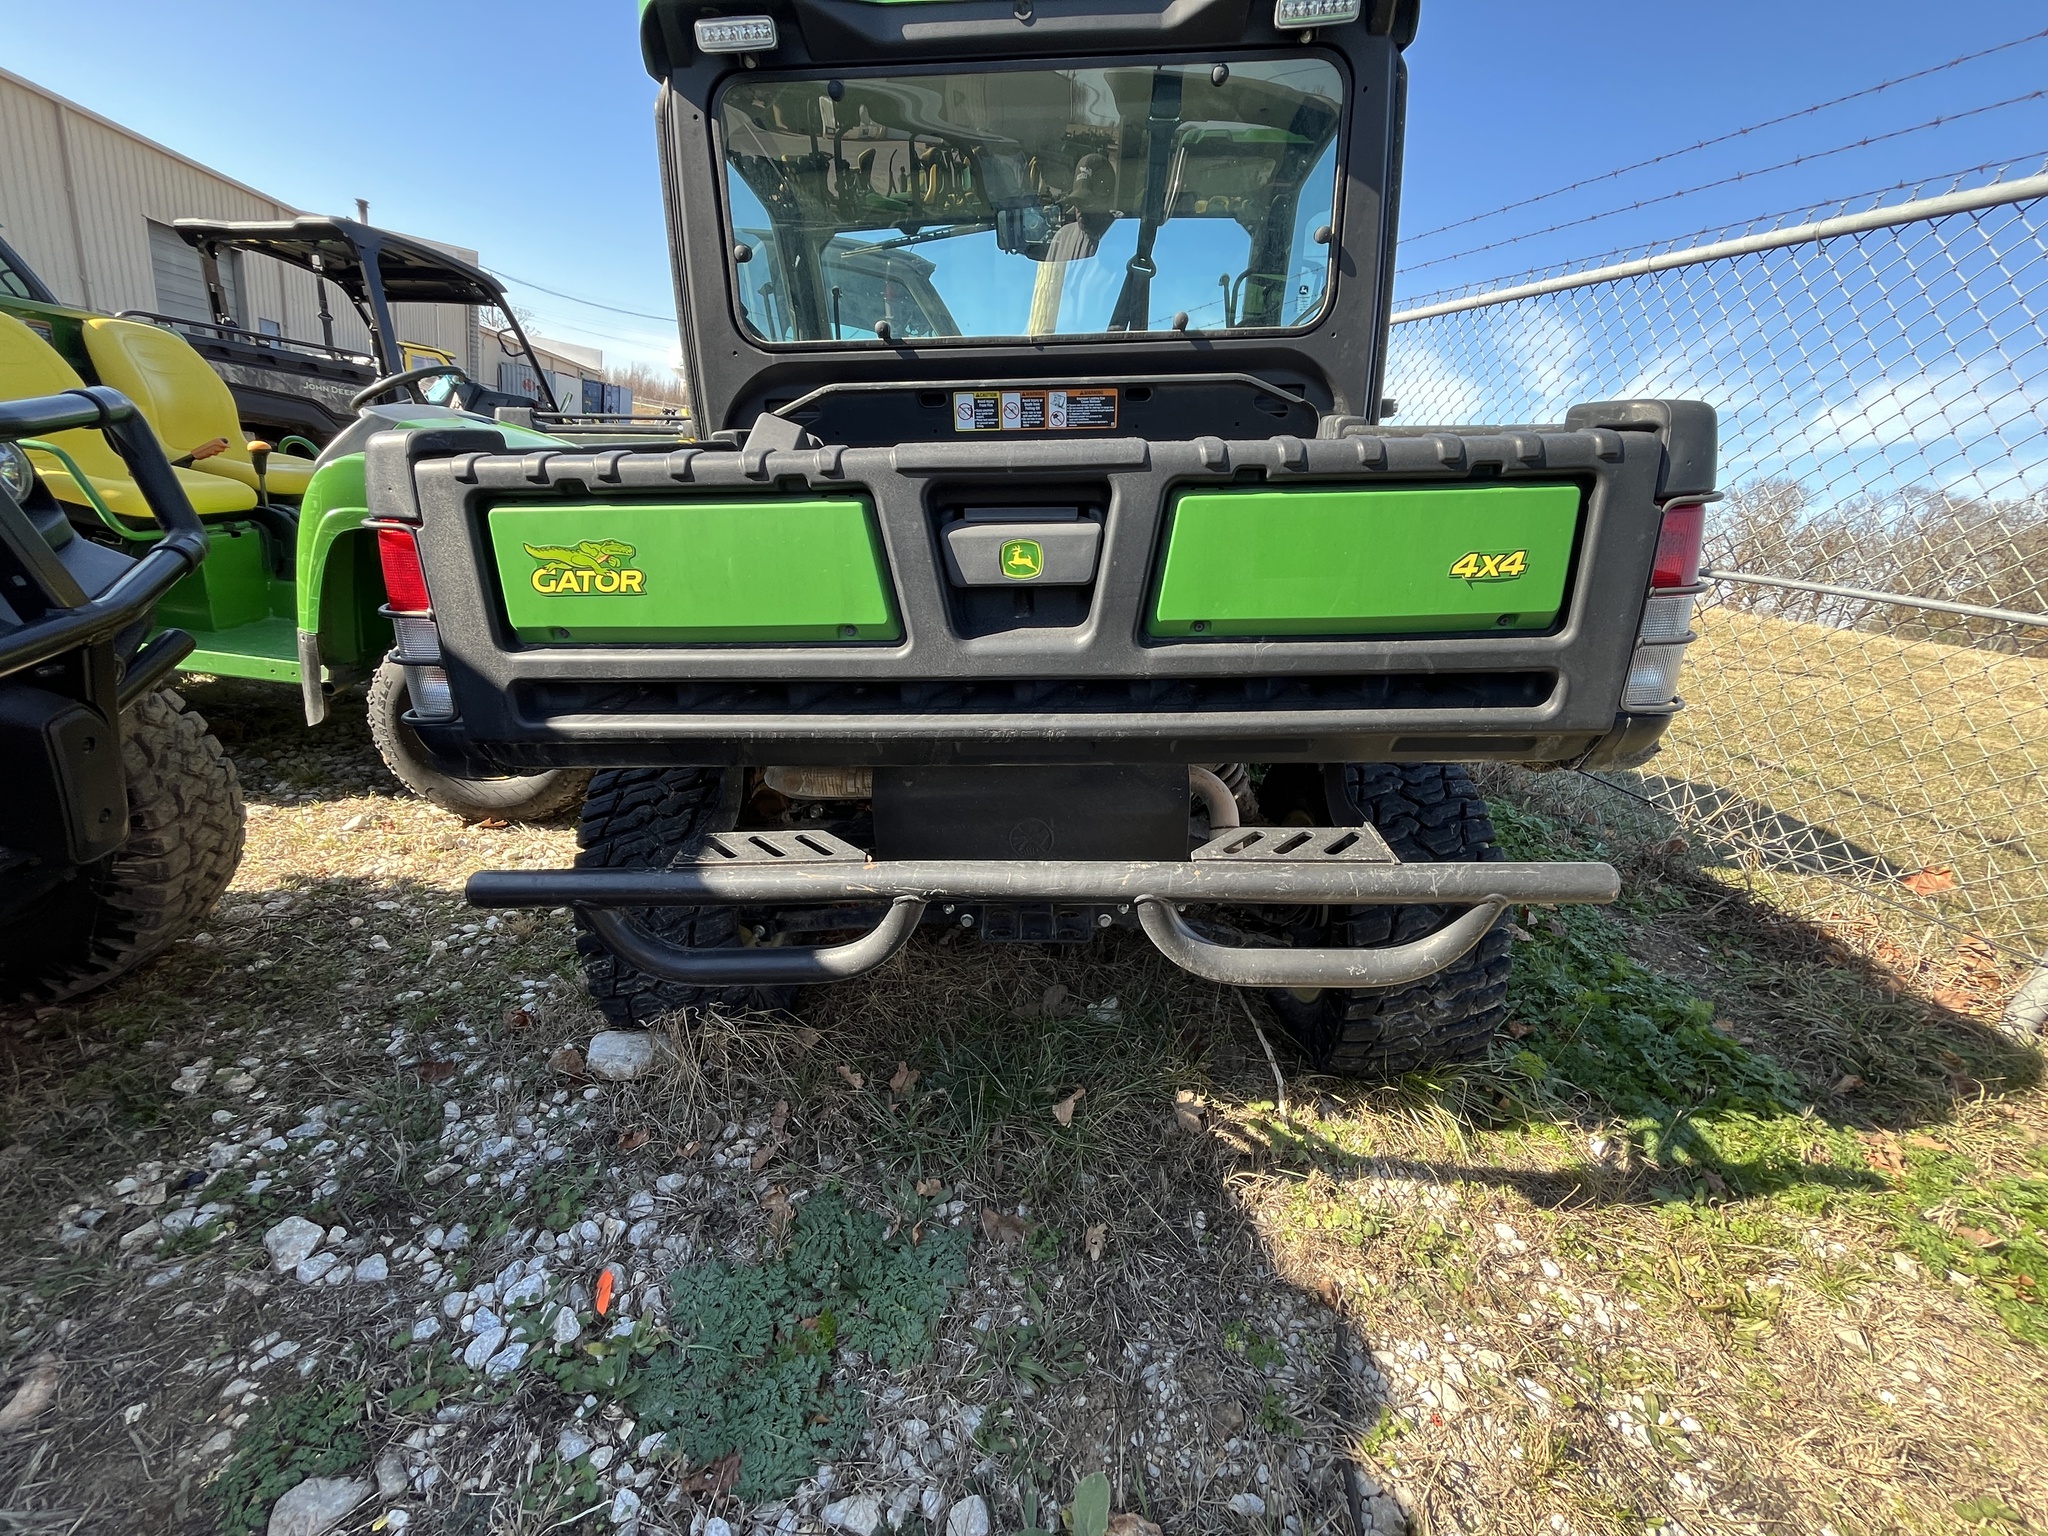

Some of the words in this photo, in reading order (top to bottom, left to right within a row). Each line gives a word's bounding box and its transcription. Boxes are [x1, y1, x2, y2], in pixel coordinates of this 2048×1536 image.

[303, 381, 330, 392] JOHN
[1450, 550, 1527, 578] 4x4
[531, 568, 643, 594] GATOR
